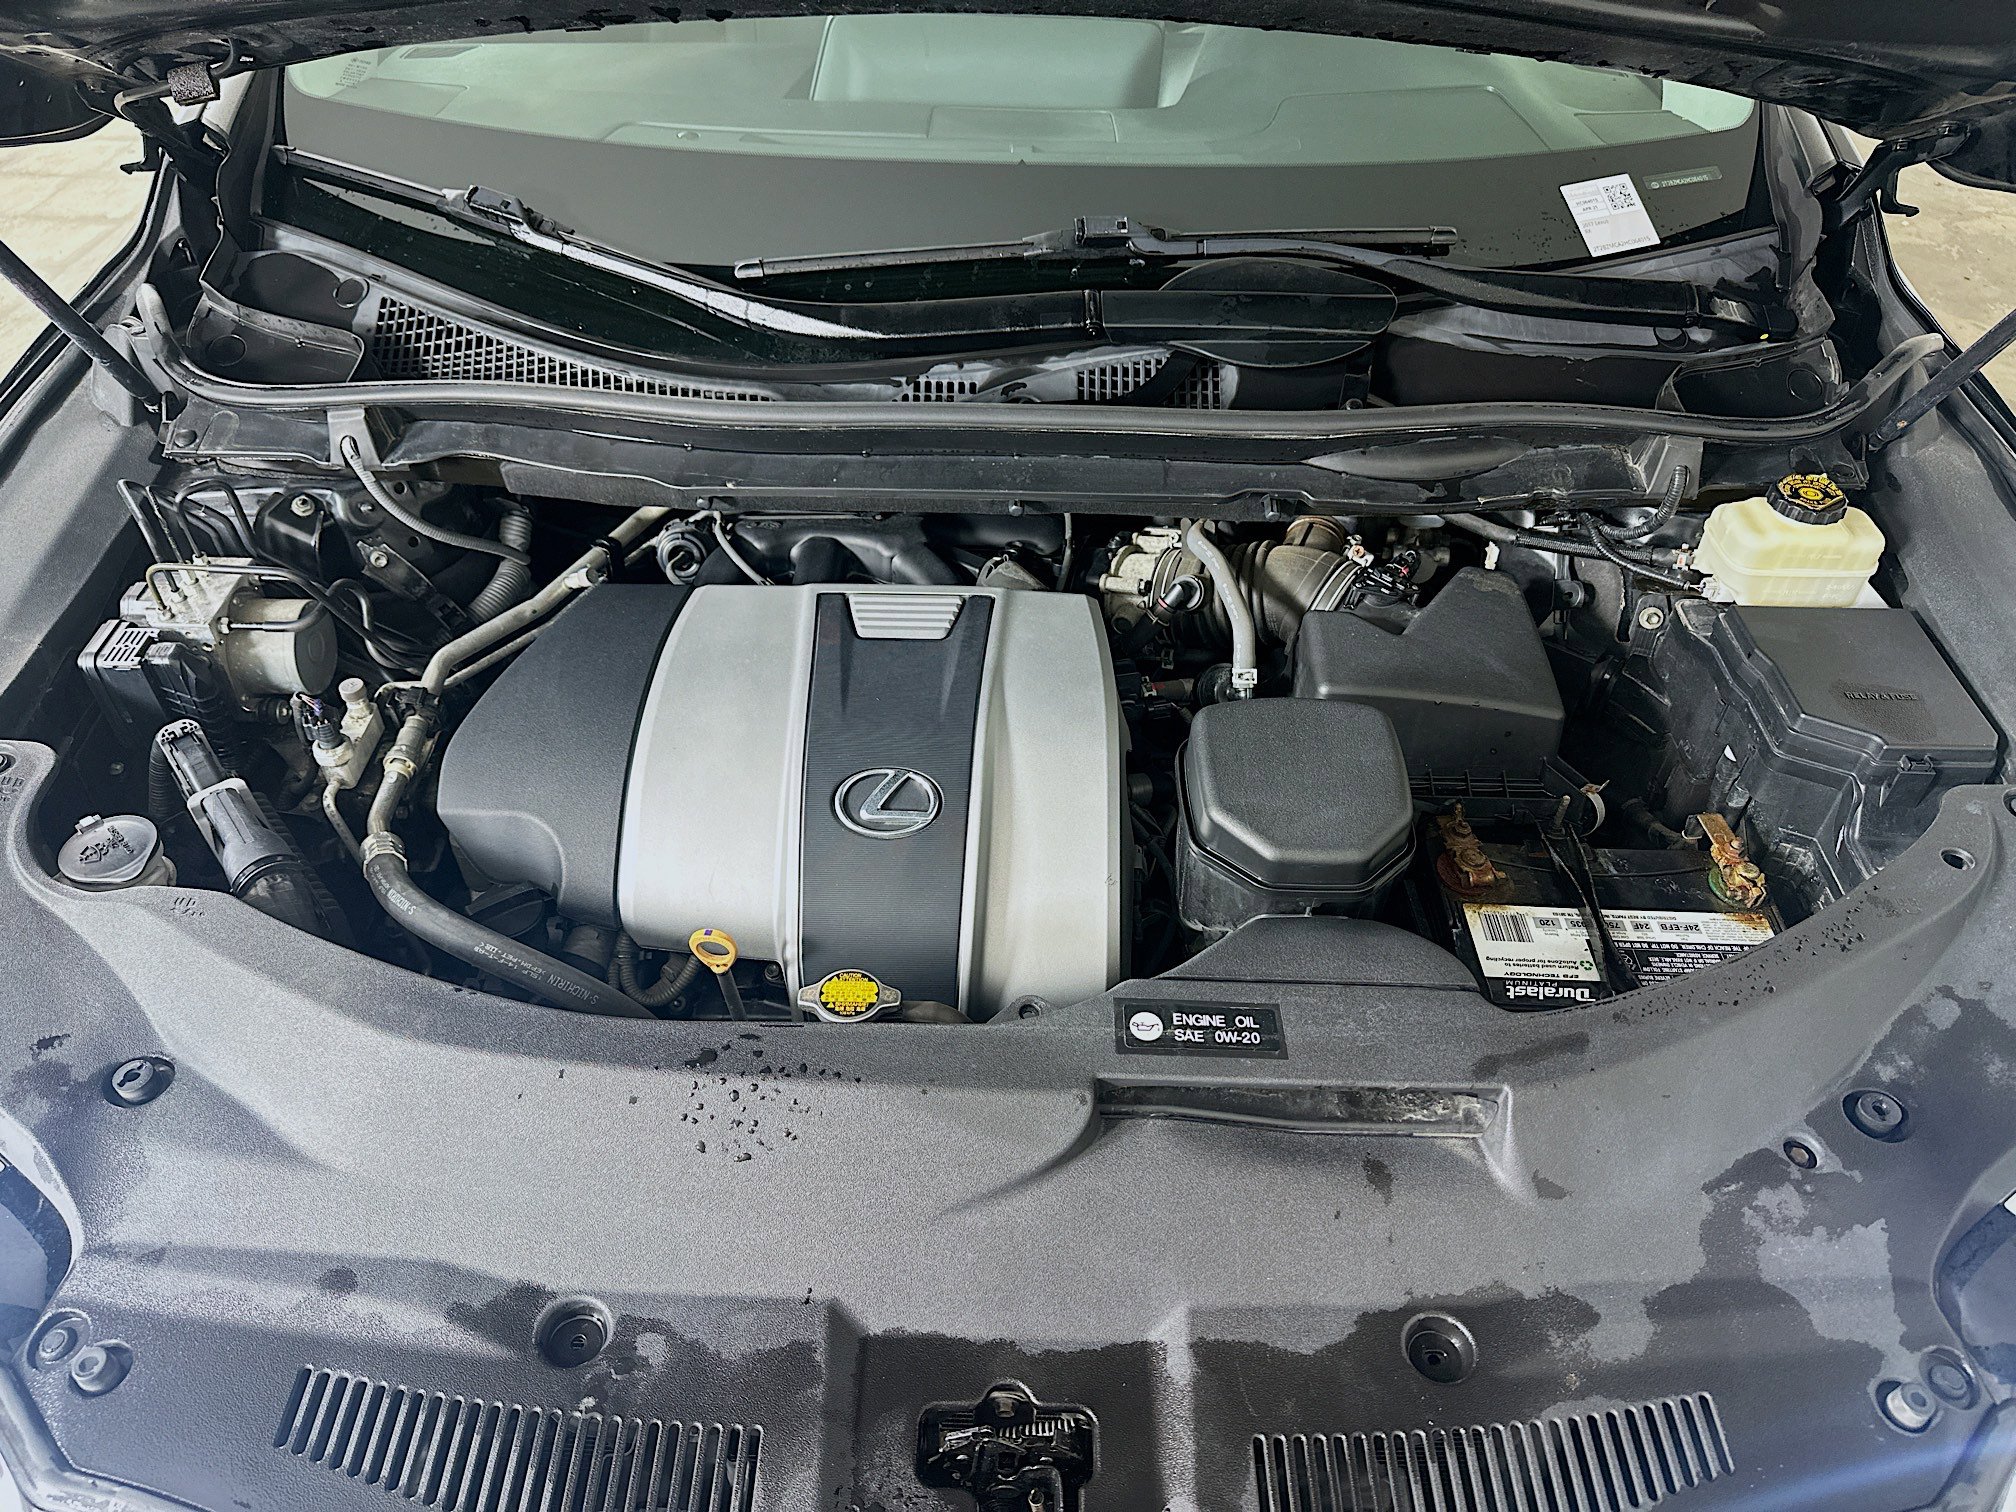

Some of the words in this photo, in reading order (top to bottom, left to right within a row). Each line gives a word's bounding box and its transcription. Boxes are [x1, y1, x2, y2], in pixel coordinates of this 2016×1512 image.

[1506, 986, 1596, 1001] Duralast
[1172, 1012, 1226, 1027] ENGINE
[1234, 1015, 1260, 1028] OIL
[1174, 1028, 1204, 1042] SAE
[1214, 1031, 1261, 1044] 0W-20
